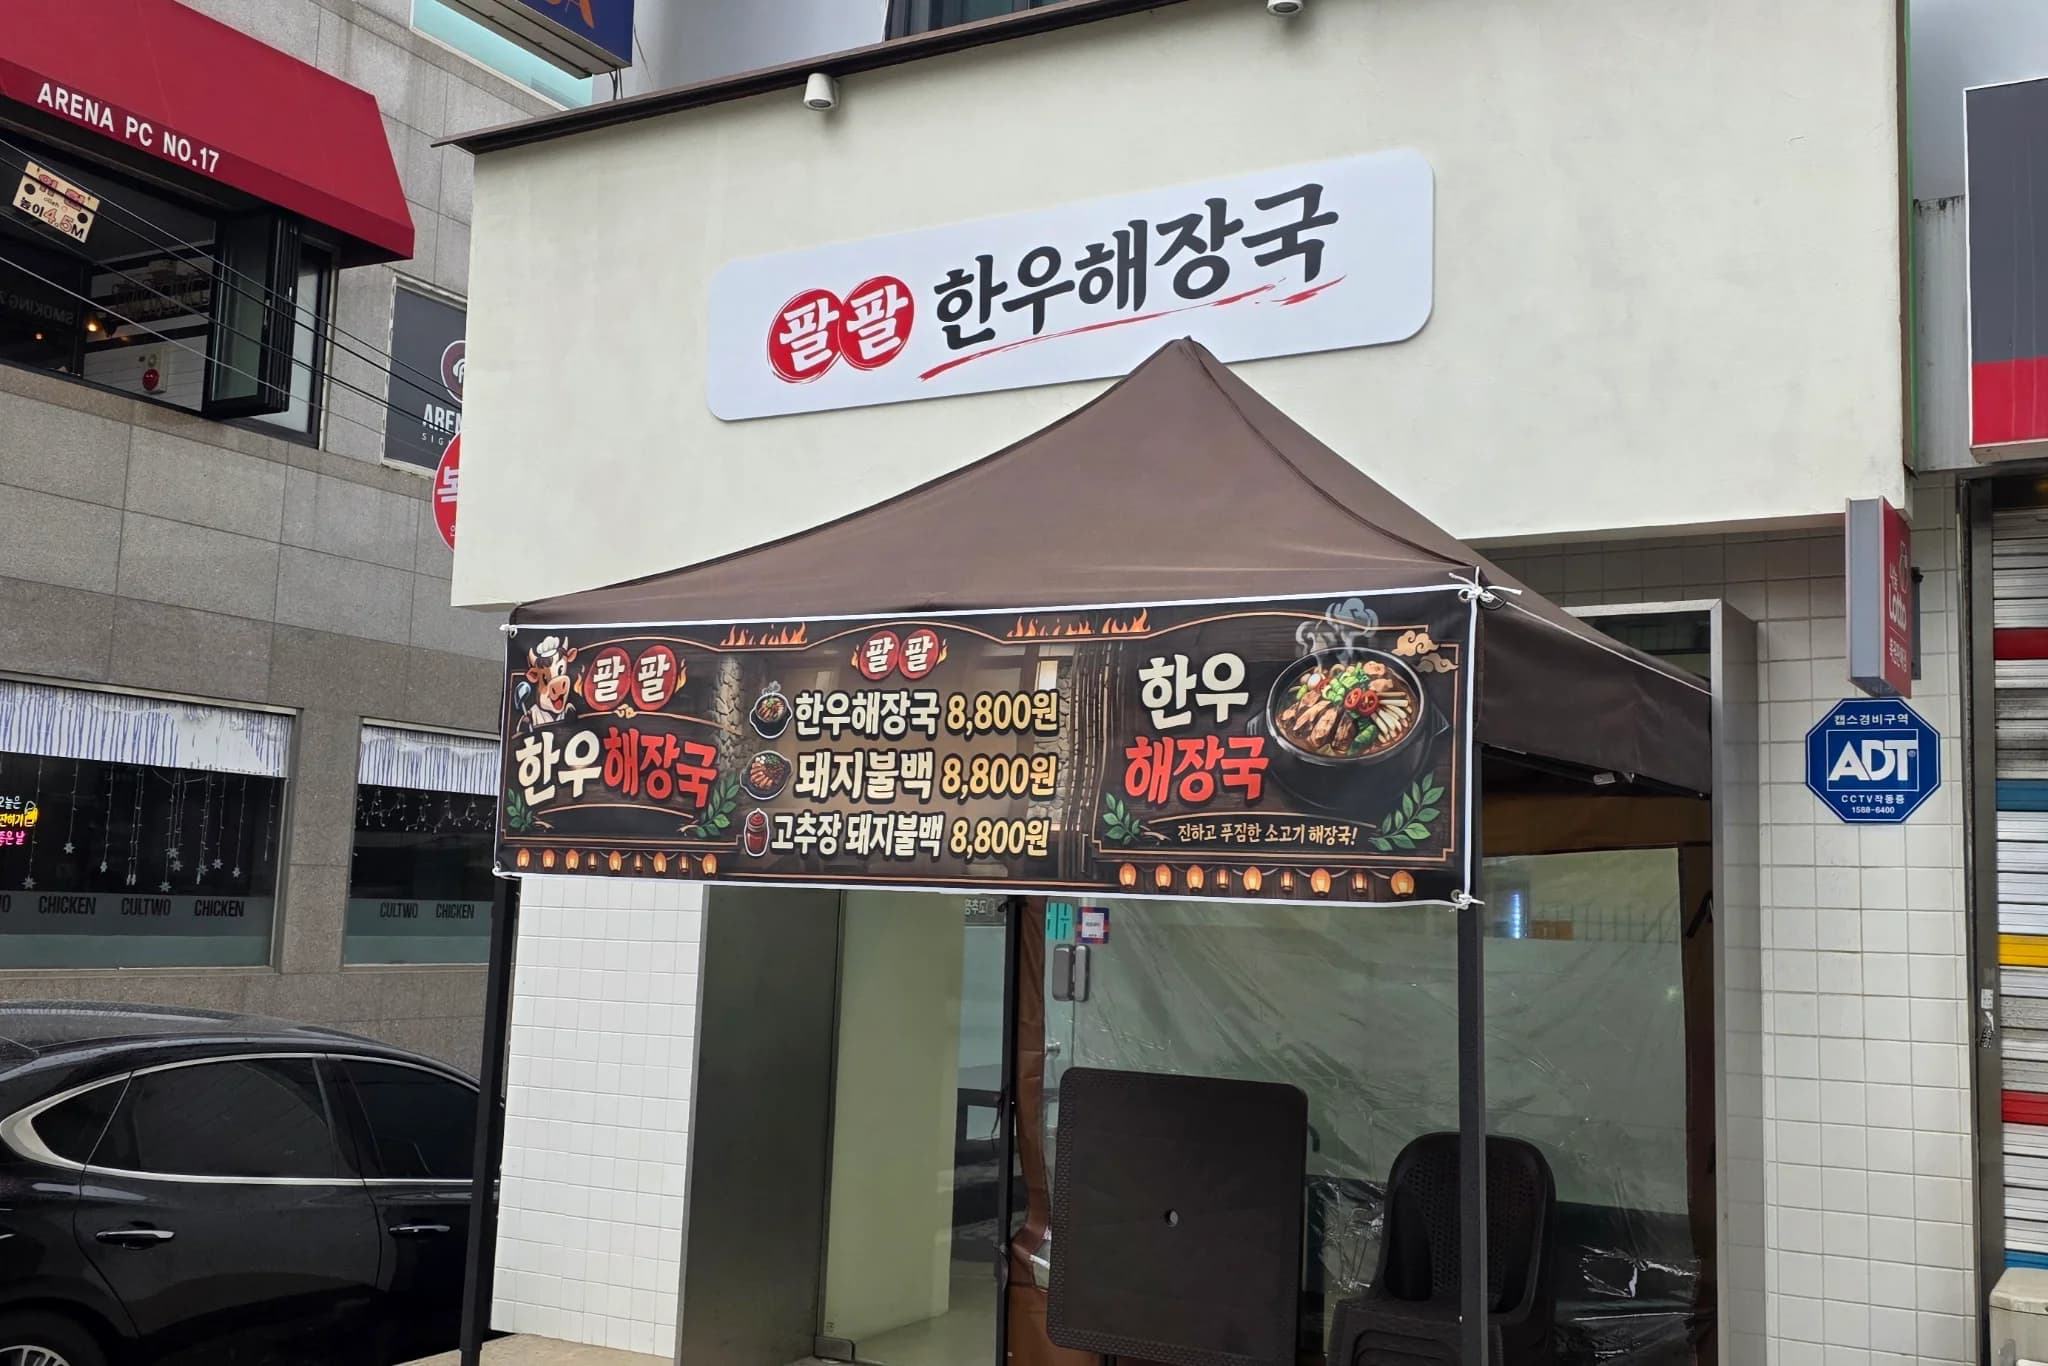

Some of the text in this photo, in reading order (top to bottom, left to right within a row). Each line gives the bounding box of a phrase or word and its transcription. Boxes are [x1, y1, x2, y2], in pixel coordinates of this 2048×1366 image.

[37, 82, 220, 174] ARENA PC NO.17
[778, 182, 1339, 373] 팔팔 한우해장국
[421, 432, 452, 446] SIG
[866, 635, 934, 673] 팔팔
[593, 653, 671, 703] 팔팔
[1138, 652, 1249, 730] 한우
[795, 691, 1058, 736] 한우해장국 8,800원
[515, 727, 718, 808] 한우해장국
[795, 751, 1057, 800] 돼지불백 8,800원
[1124, 735, 1270, 804] 해장국
[1828, 739, 1918, 781] ADT
[1851, 806, 1895, 814] 1588-6400
[771, 813, 1050, 859] 고추장 돼지불백 8,800원
[1177, 822, 1358, 846] 진하고 푸짐한 소고기 해장국!
[38, 894, 244, 917] CHICKEN CULTWO CHICKEN
[380, 902, 475, 919] CULTWO CHICKEN
